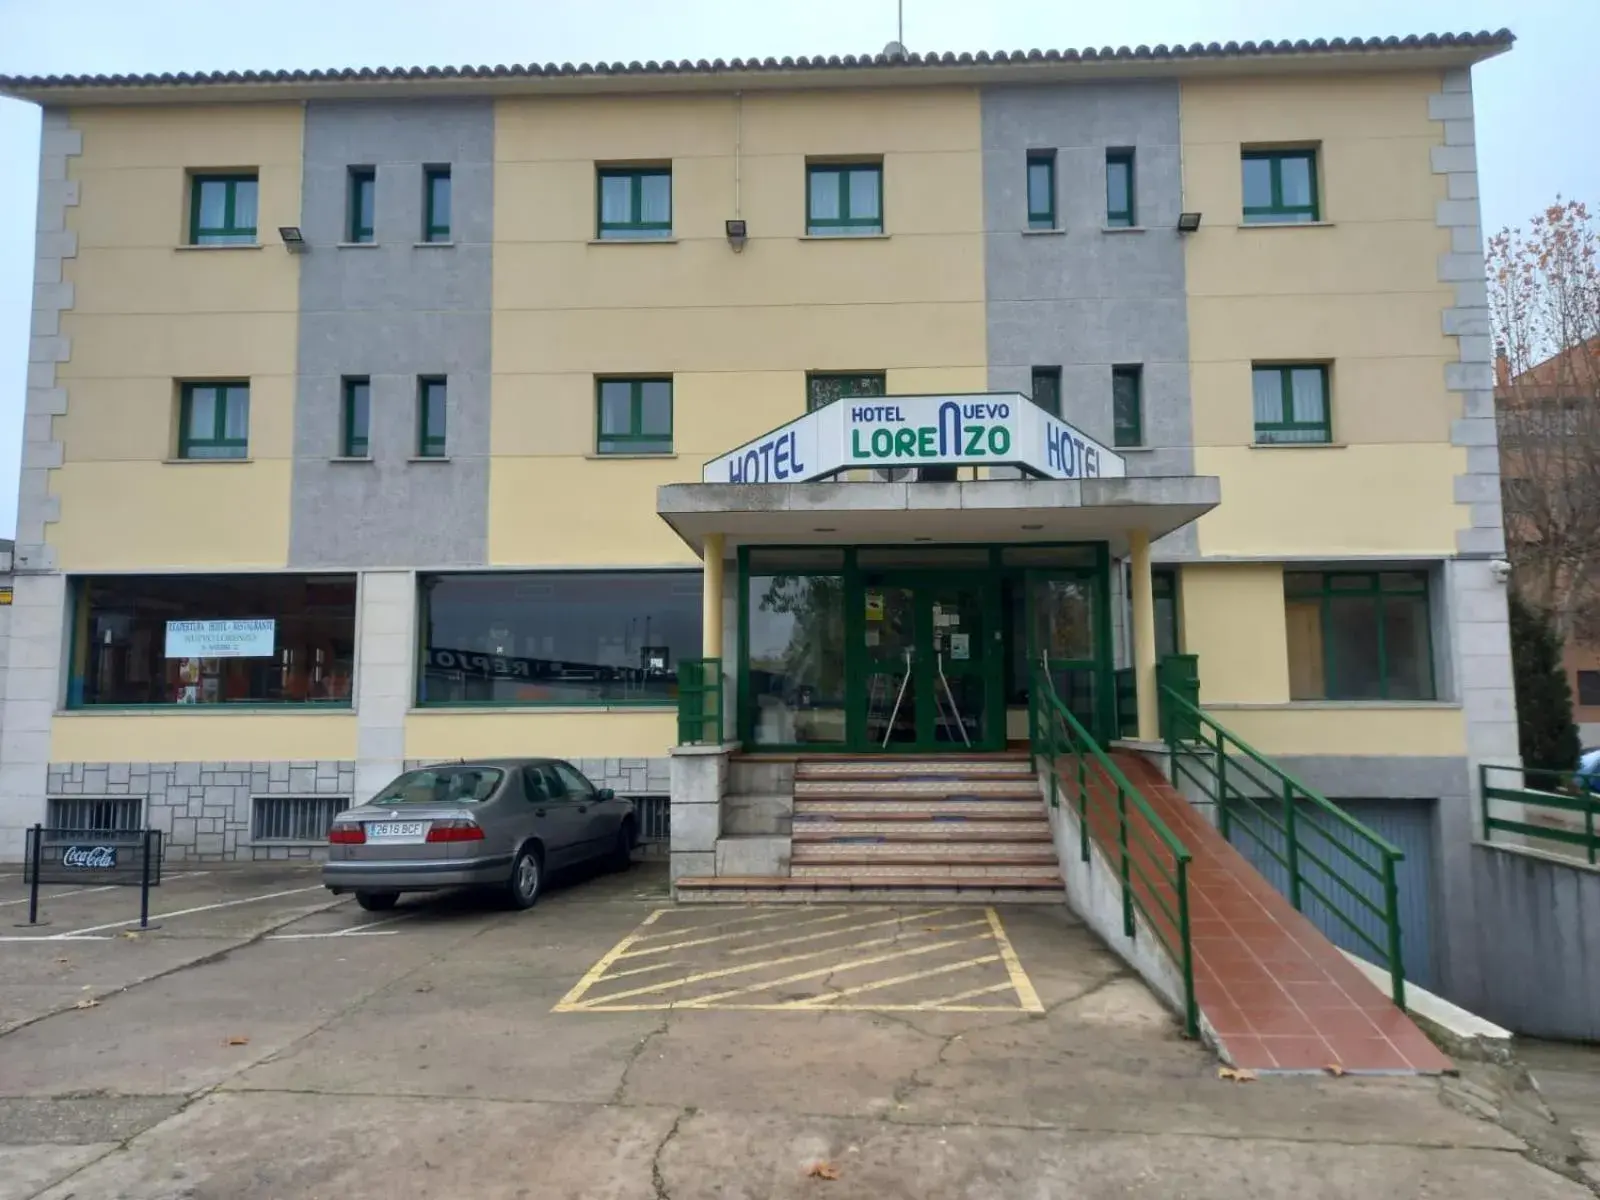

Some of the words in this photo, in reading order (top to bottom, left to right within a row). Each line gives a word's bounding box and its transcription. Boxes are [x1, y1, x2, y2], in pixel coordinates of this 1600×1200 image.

[852, 407, 905, 422] HOTEL
[729, 431, 804, 483] HOTEL
[852, 425, 1011, 458] LORENZO
[1047, 421, 1100, 479] HOTEL
[376, 823, 399, 834] 2616
